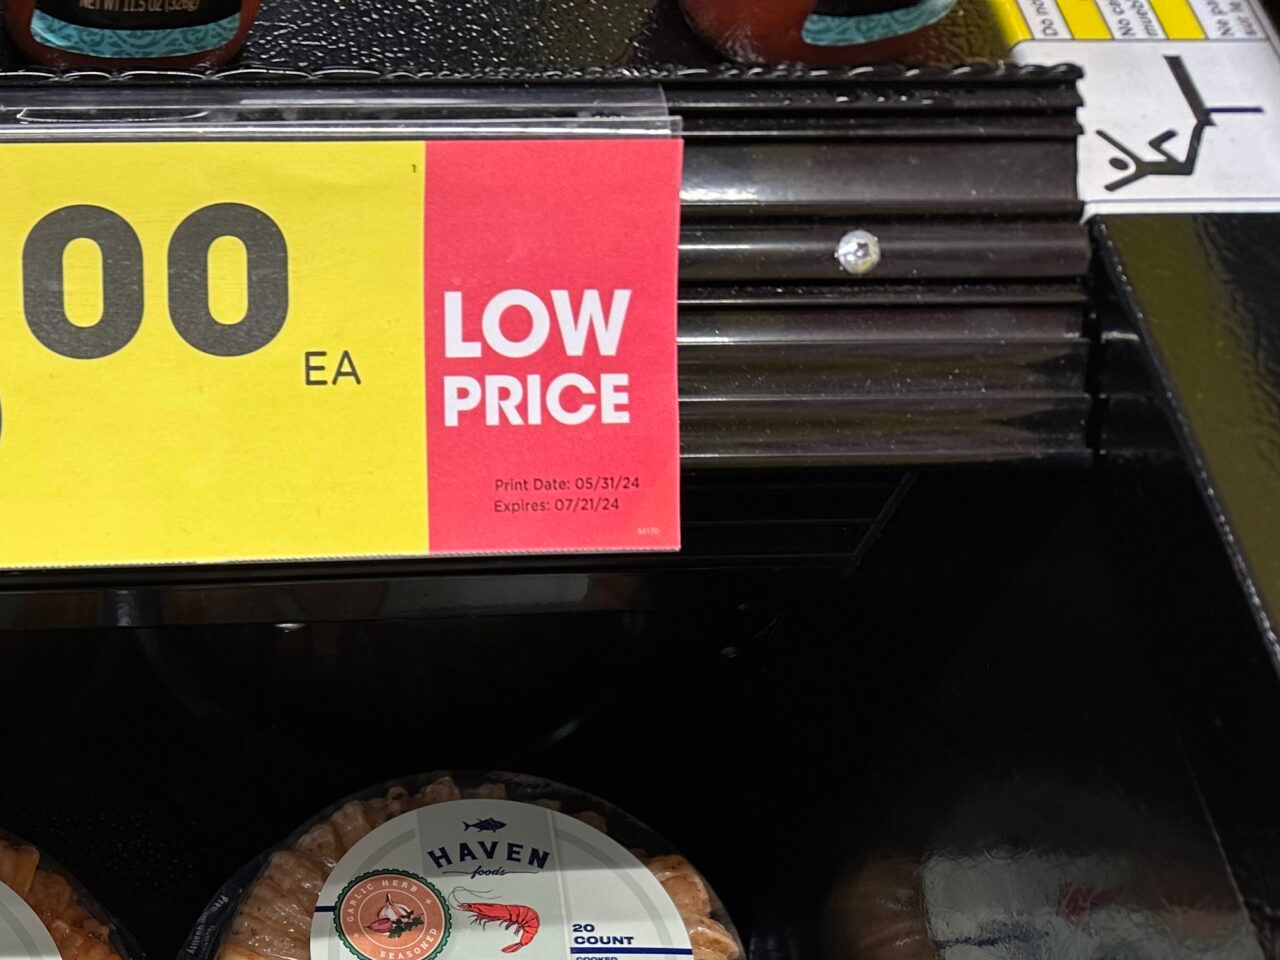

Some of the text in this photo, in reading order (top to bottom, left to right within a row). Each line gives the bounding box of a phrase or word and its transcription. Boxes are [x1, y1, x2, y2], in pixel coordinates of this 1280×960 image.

[444, 288, 632, 358] LOW
[305, 350, 362, 386] EA
[443, 373, 631, 427] PRICE
[495, 476, 640, 491] Print Date: 05/31/24
[494, 498, 619, 515] Expires: 07/21/24
[427, 841, 550, 869] HAVEN
[572, 923, 595, 933] 20
[574, 936, 634, 945] COUNT
[380, 928, 437, 960] SEASONED
